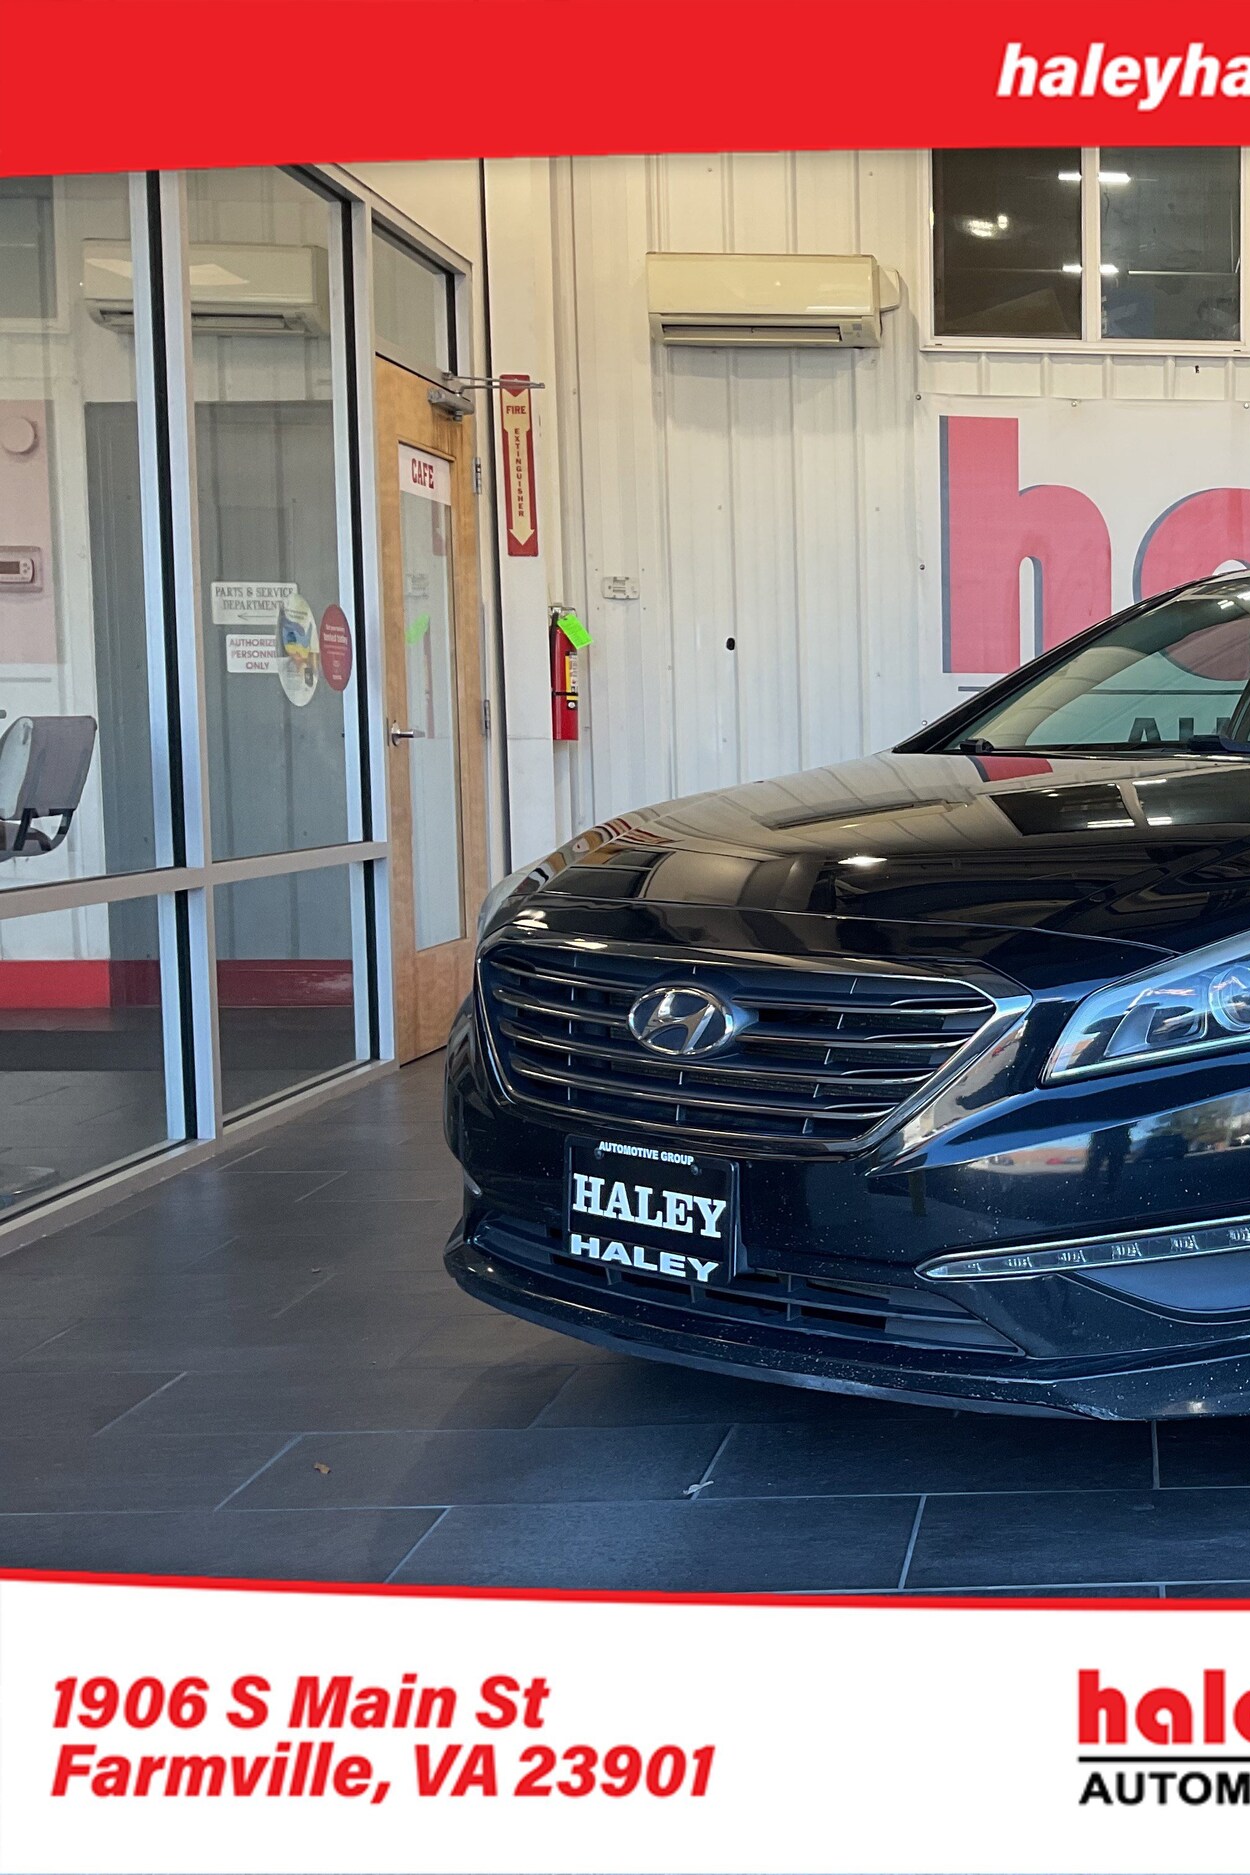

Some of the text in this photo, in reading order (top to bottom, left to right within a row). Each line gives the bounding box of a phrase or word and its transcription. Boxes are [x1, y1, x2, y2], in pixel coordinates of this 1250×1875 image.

[505, 405, 527, 415] FIRE
[411, 458, 435, 490] CAFE
[513, 427, 525, 517] EXTINGUISHER
[215, 586, 244, 598] PARTS
[246, 586, 254, 597] &
[245, 661, 270, 670] ONLY
[598, 1141, 695, 1166] AUTOMOTIVE GROUP
[572, 1172, 727, 1239] HALEY
[570, 1233, 720, 1283] HALEY
